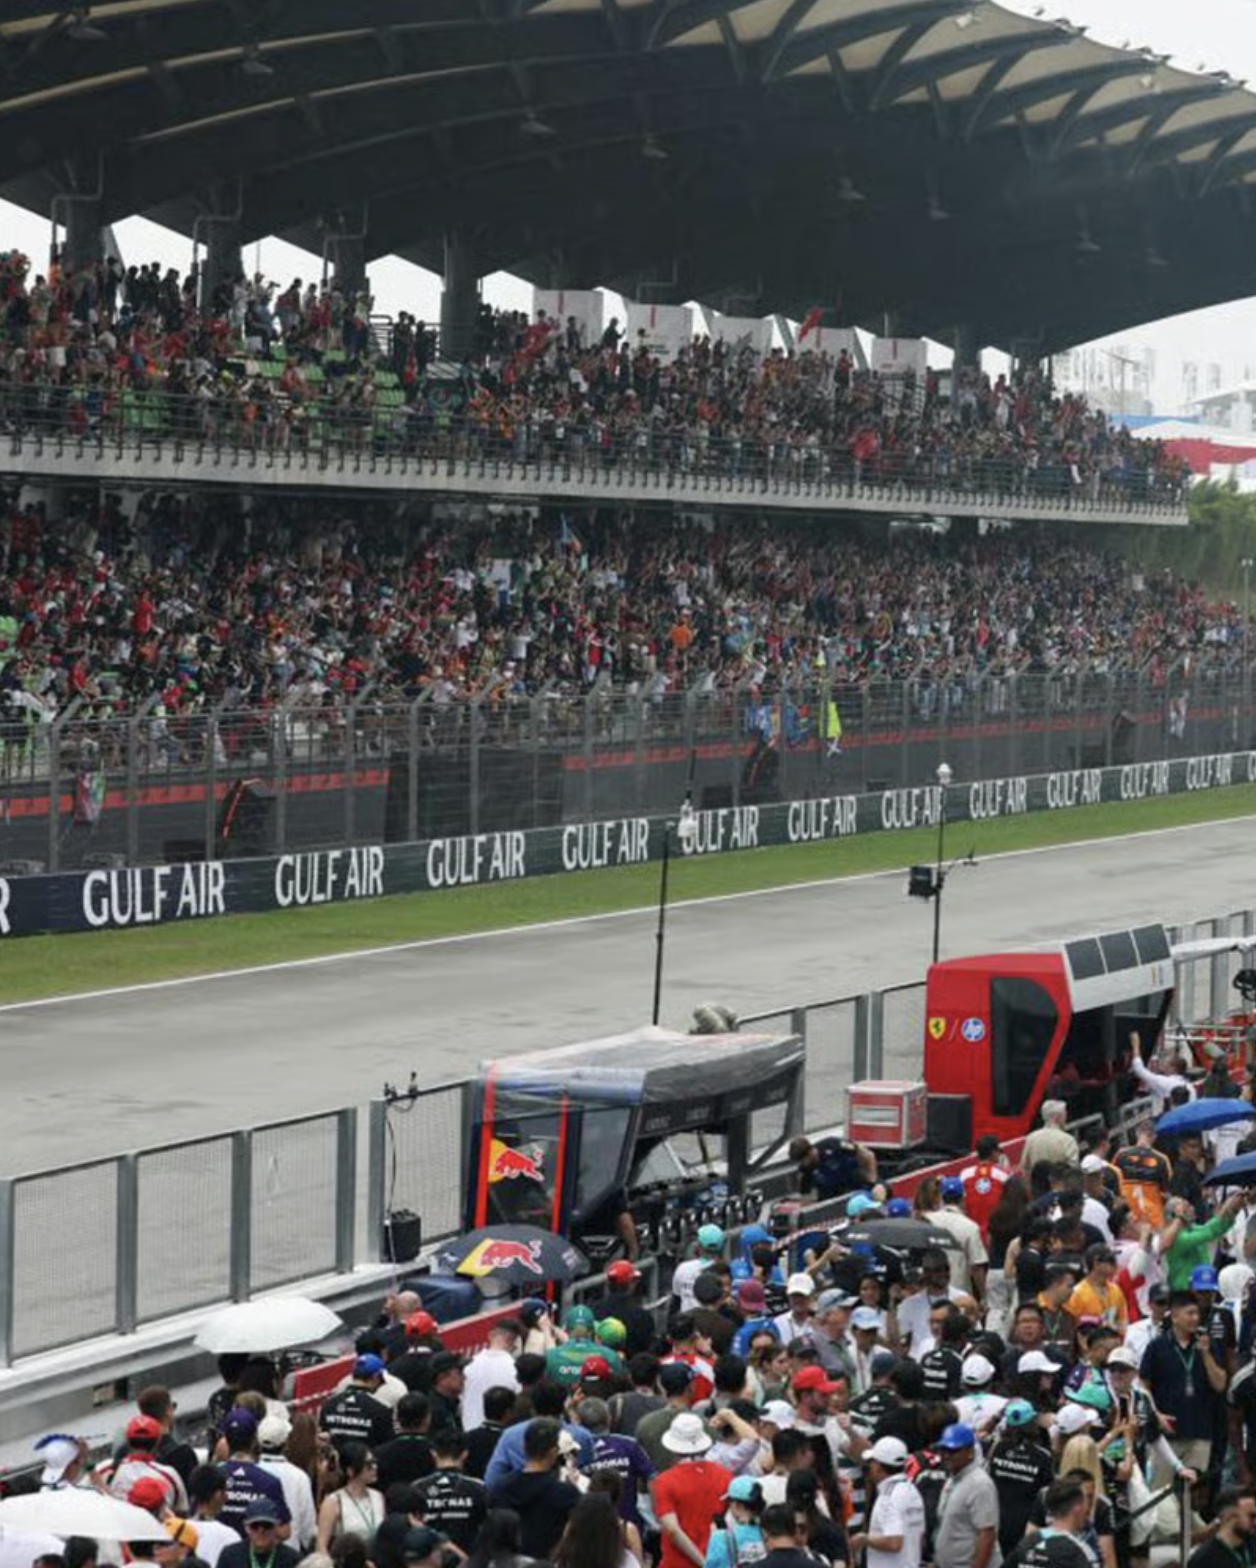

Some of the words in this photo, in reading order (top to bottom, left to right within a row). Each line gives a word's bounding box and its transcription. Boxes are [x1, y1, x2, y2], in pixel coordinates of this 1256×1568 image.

[1047, 770, 1080, 808] GULF
[1080, 768, 1101, 804] AIR
[1121, 764, 1150, 800] GULF
[1151, 761, 1169, 795] AIR
[1186, 756, 1215, 790] GULF
[1215, 753, 1232, 787] AIR
[788, 797, 830, 842] GULF
[831, 795, 857, 835] AIR
[881, 788, 921, 829] GULF
[969, 779, 1005, 820] GULF
[1005, 777, 1027, 813] AIR
[562, 820, 616, 870] GULF
[617, 817, 649, 864] AIR
[730, 804, 759, 849] AIR
[275, 850, 339, 907] GULF
[344, 845, 385, 898] AIR
[427, 835, 487, 888] GULF
[490, 831, 525, 880] AIR
[83, 865, 173, 927] GULF
[176, 860, 226, 917] AIR
[993, 1458, 1039, 1474] PETRONAS
